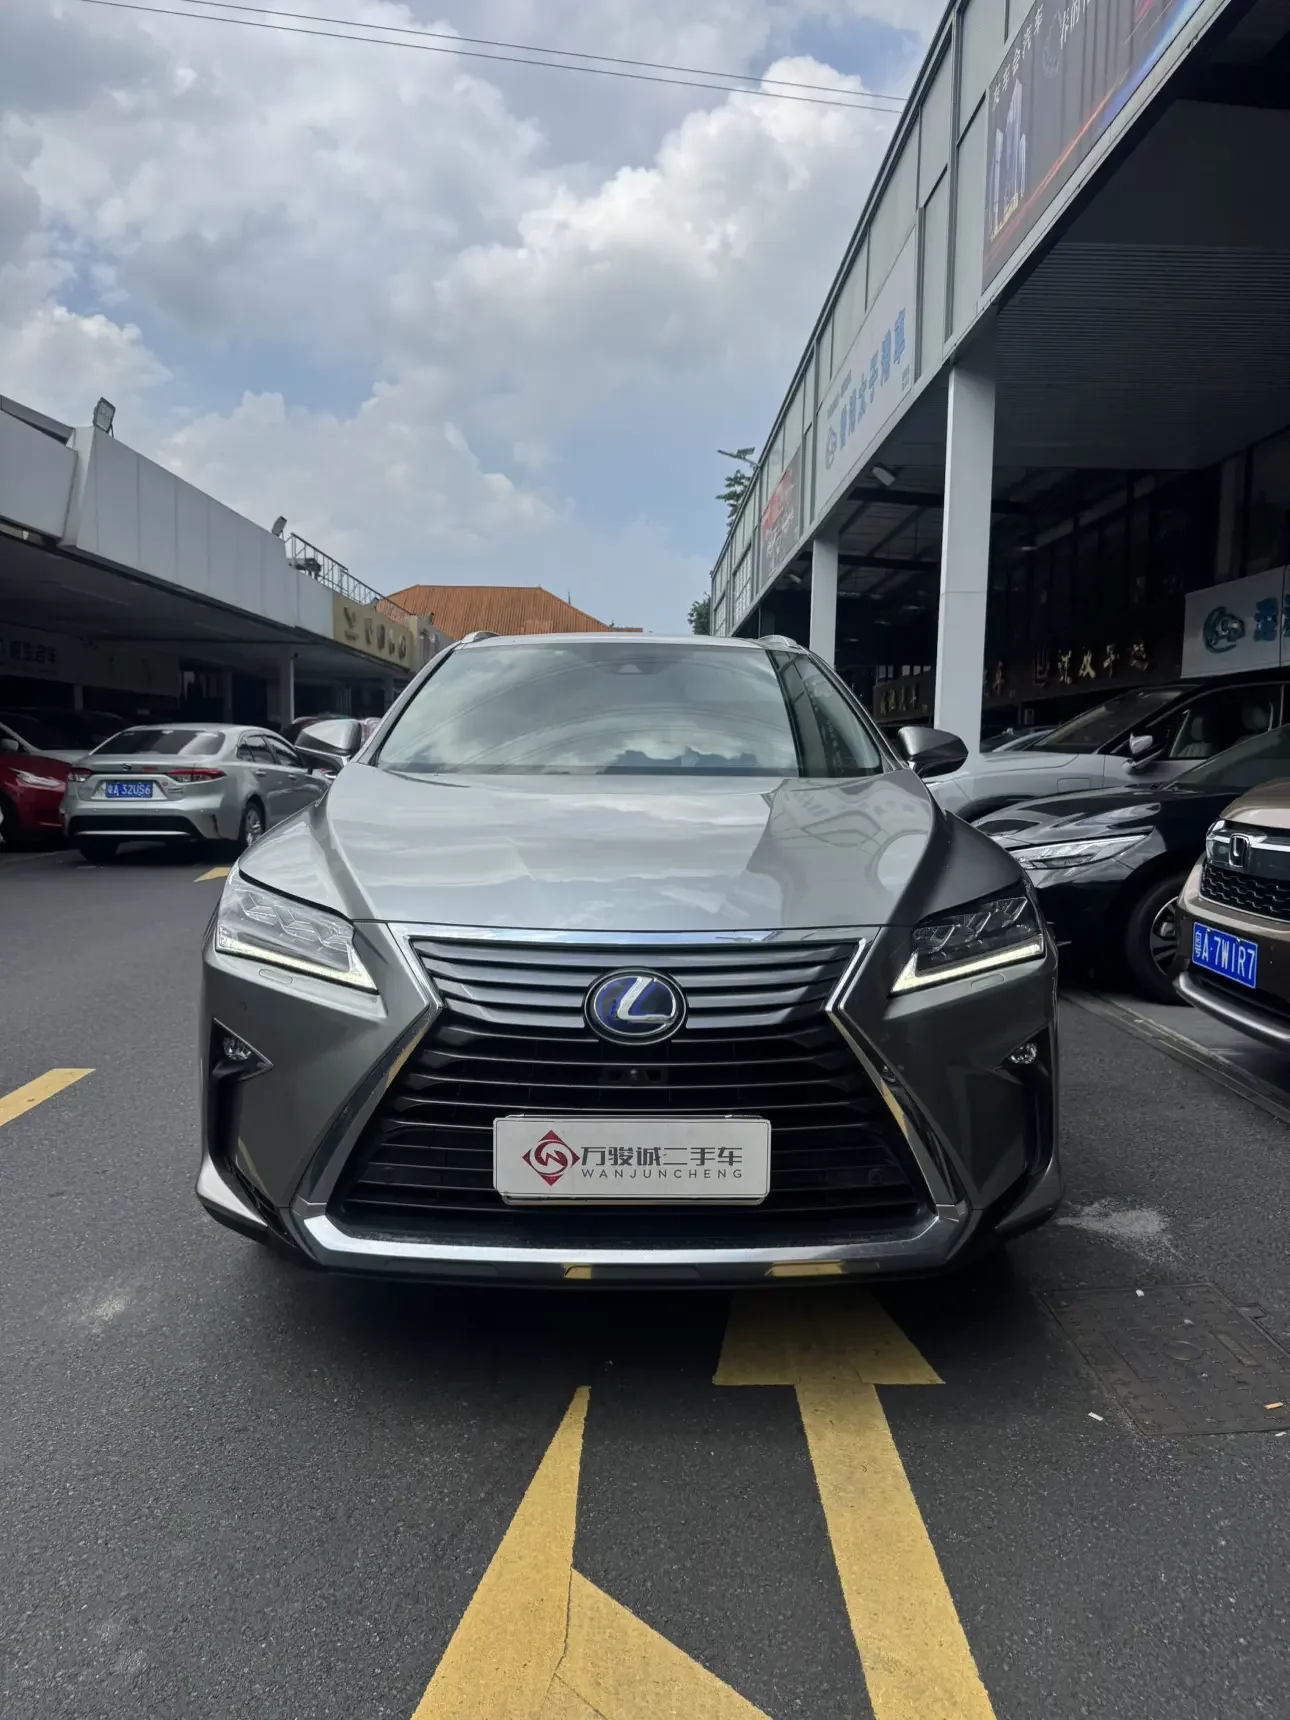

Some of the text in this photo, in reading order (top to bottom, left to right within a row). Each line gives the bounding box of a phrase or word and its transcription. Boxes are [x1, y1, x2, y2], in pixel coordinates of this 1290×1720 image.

[581, 1146, 743, 1168] 万骏诚二手车
[581, 1168, 743, 1179] WANJUNCHENG
